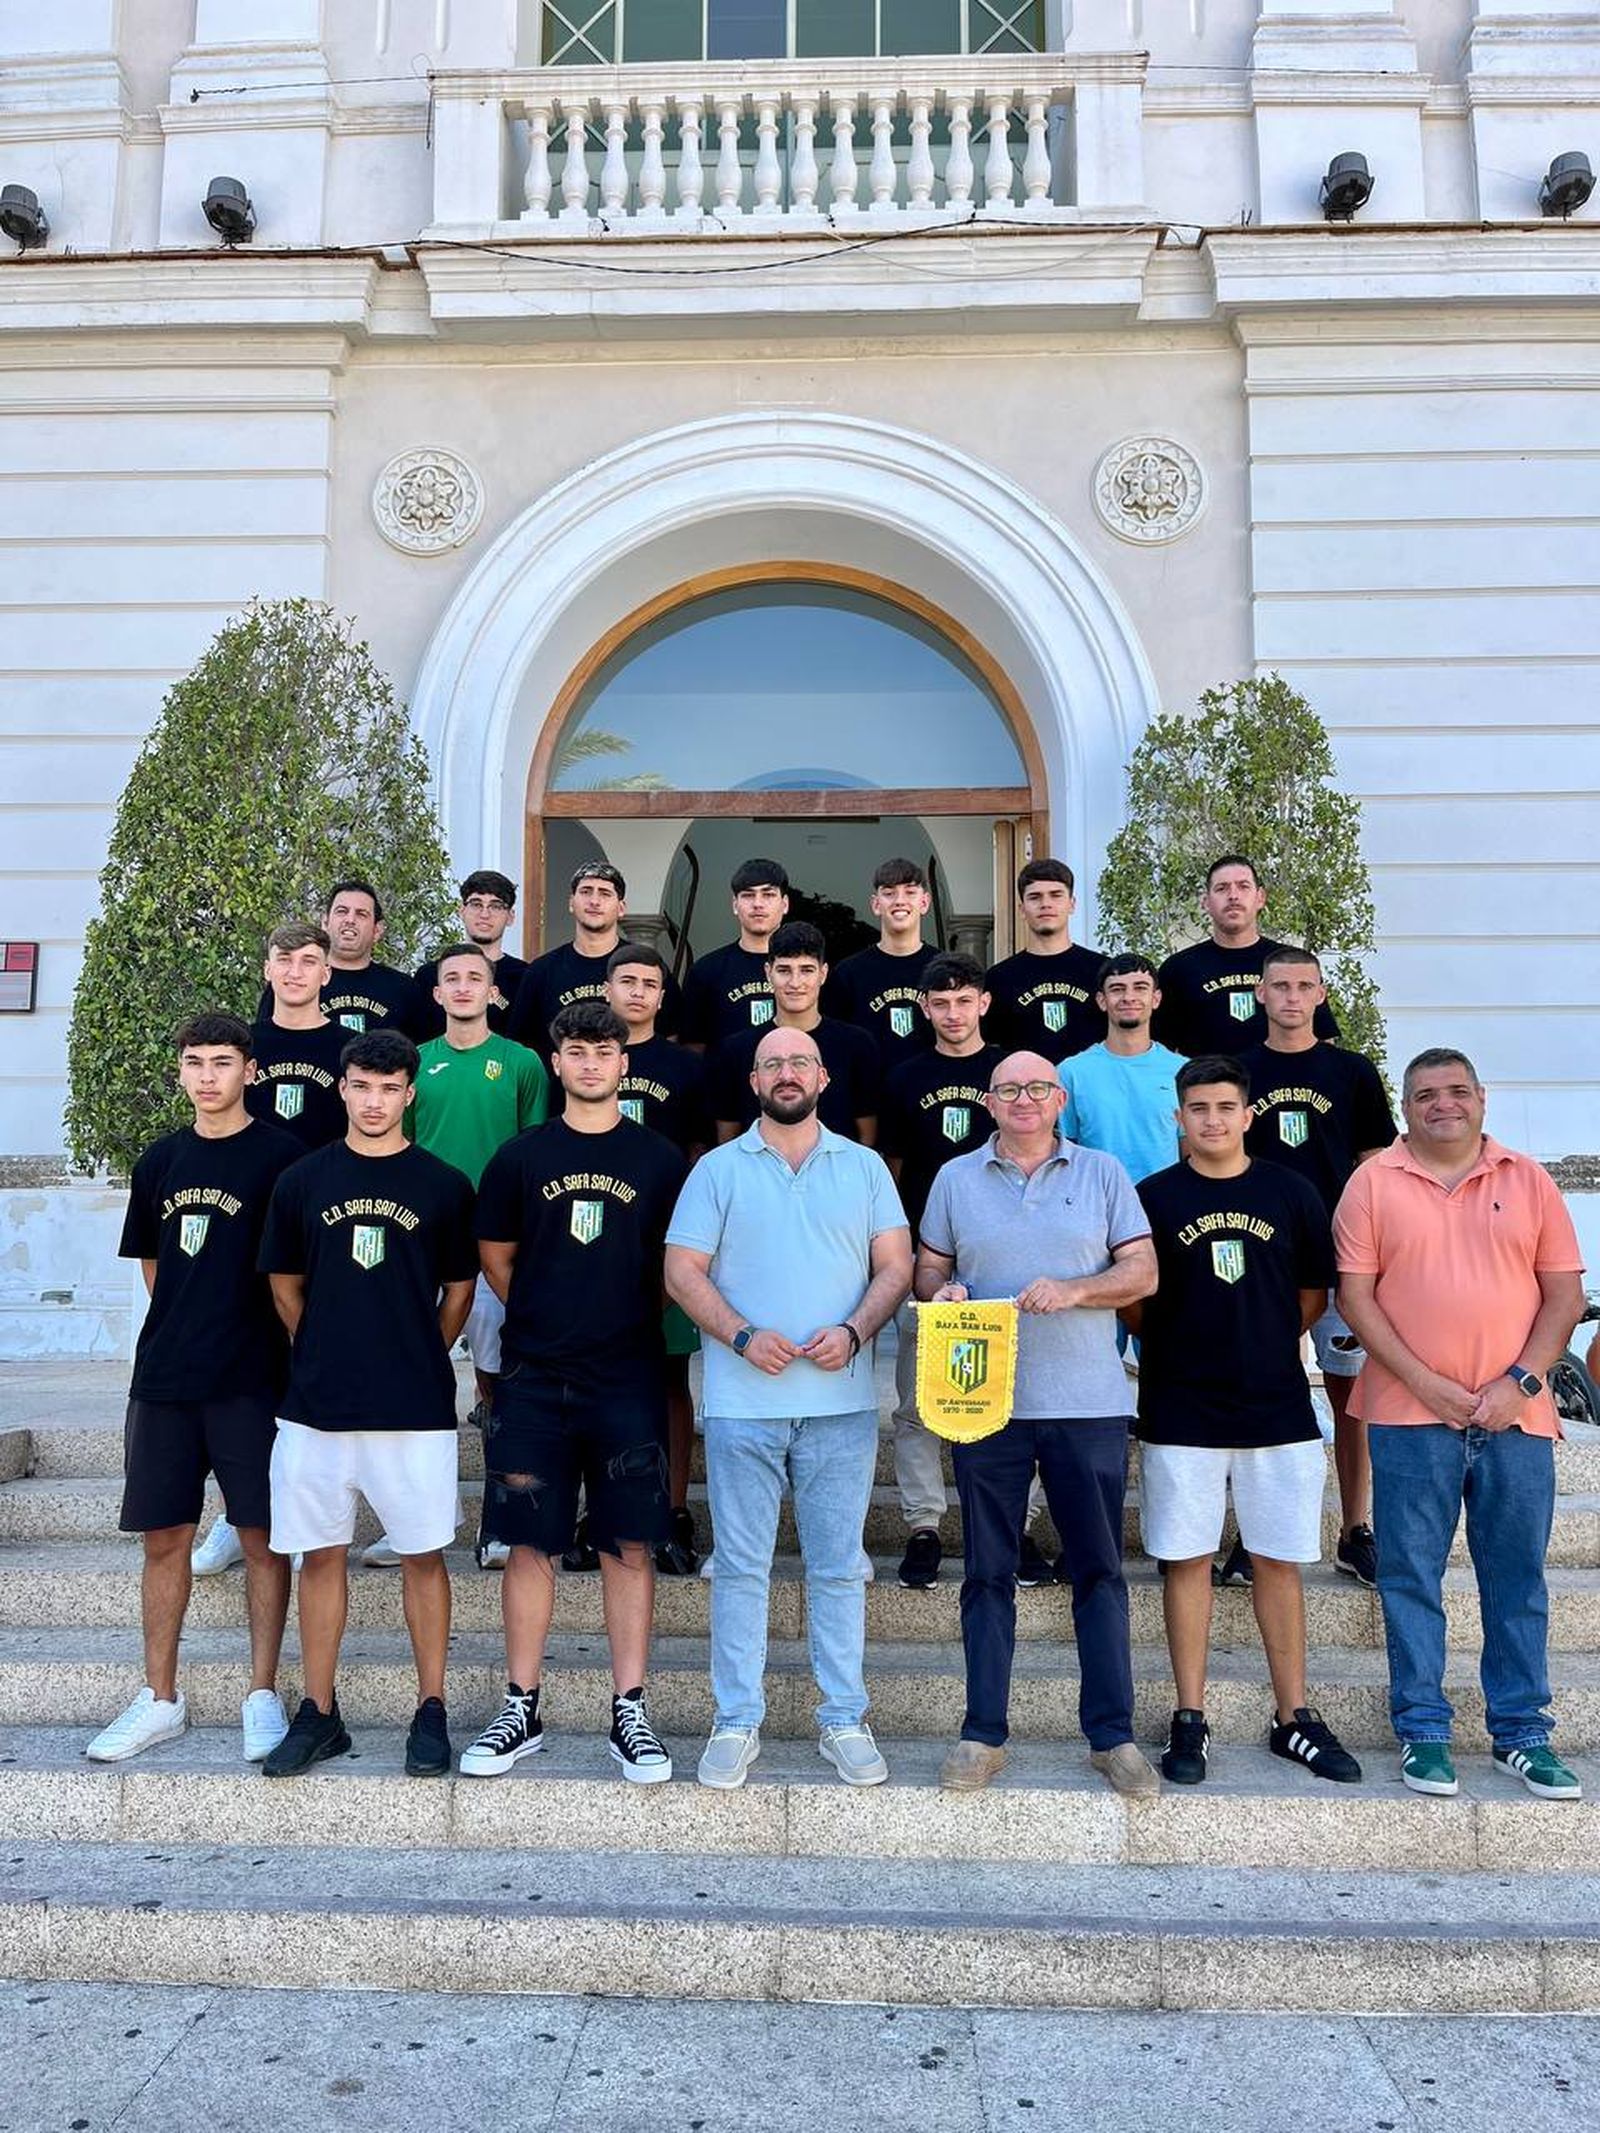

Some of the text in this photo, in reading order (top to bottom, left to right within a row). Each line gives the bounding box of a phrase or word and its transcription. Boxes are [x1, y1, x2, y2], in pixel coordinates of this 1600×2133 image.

[574, 984, 595, 999] SAFA
[763, 982, 774, 993] SA
[1220, 975, 1242, 988] SAFA
[883, 988, 902, 1003] SAFA
[1033, 983, 1053, 997] SAFA
[1054, 983, 1071, 995] SAN
[1070, 986, 1089, 1003] LUIS
[330, 996, 352, 1010] SAFA
[353, 996, 370, 1009] SAN
[369, 1001, 389, 1018] LUIS
[268, 1063, 293, 1078] SAFA
[294, 1063, 314, 1078] SAN
[312, 1067, 335, 1088] LUIS
[617, 1077, 670, 1102] FA SAN LUIS
[936, 1086, 959, 1102] SAFA
[960, 1086, 978, 1101] SAN
[1268, 1088, 1293, 1105] SAFA
[1293, 1088, 1312, 1102] SAN
[1311, 1092, 1333, 1114] LUIS
[542, 1172, 637, 1203] C.D. SAFA SAN LUIS
[174, 1187, 201, 1208] SAFA
[201, 1187, 222, 1206] SAN
[218, 1193, 242, 1216] LUIS
[321, 1198, 420, 1231] C.D. SAFA SAN LUIS
[1178, 1211, 1275, 1246] C.D. SAFA SAN LUIS
[959, 1312, 978, 1321] C.D.
